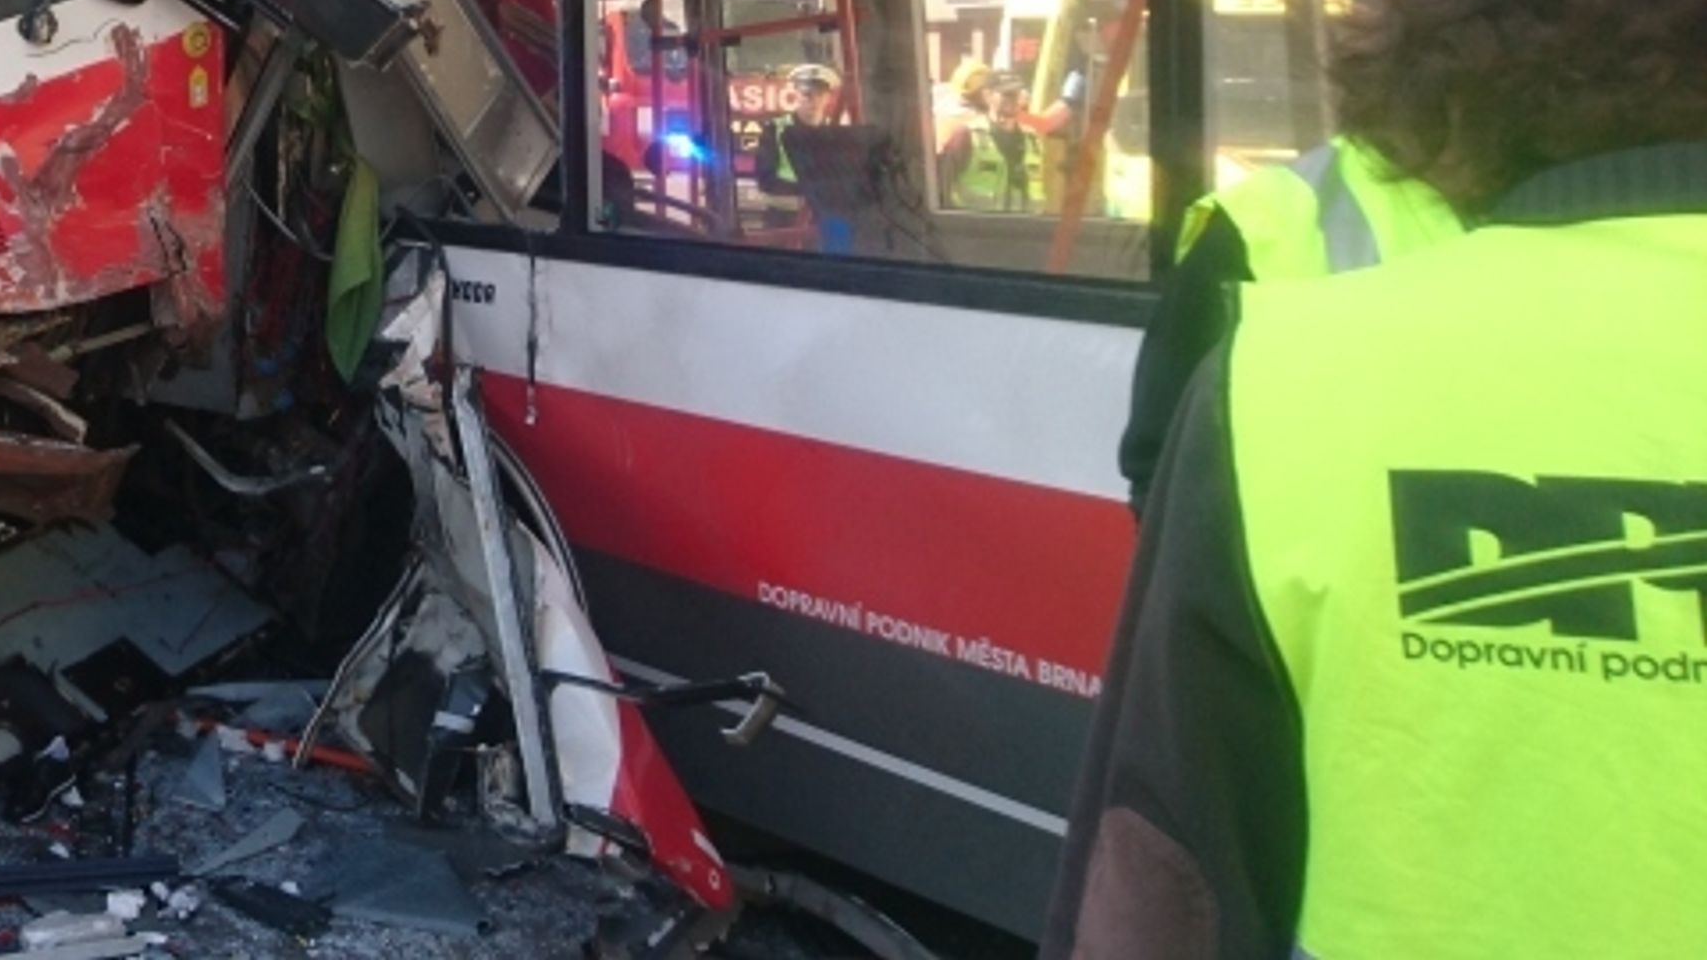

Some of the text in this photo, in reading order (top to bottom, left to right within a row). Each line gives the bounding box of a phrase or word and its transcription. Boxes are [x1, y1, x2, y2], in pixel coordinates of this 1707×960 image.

[757, 581, 862, 631] DOPRAVNÍ
[865, 611, 951, 657] PODNIK
[956, 636, 1031, 680] MĚSTA
[1401, 632, 1588, 673] Dopravní
